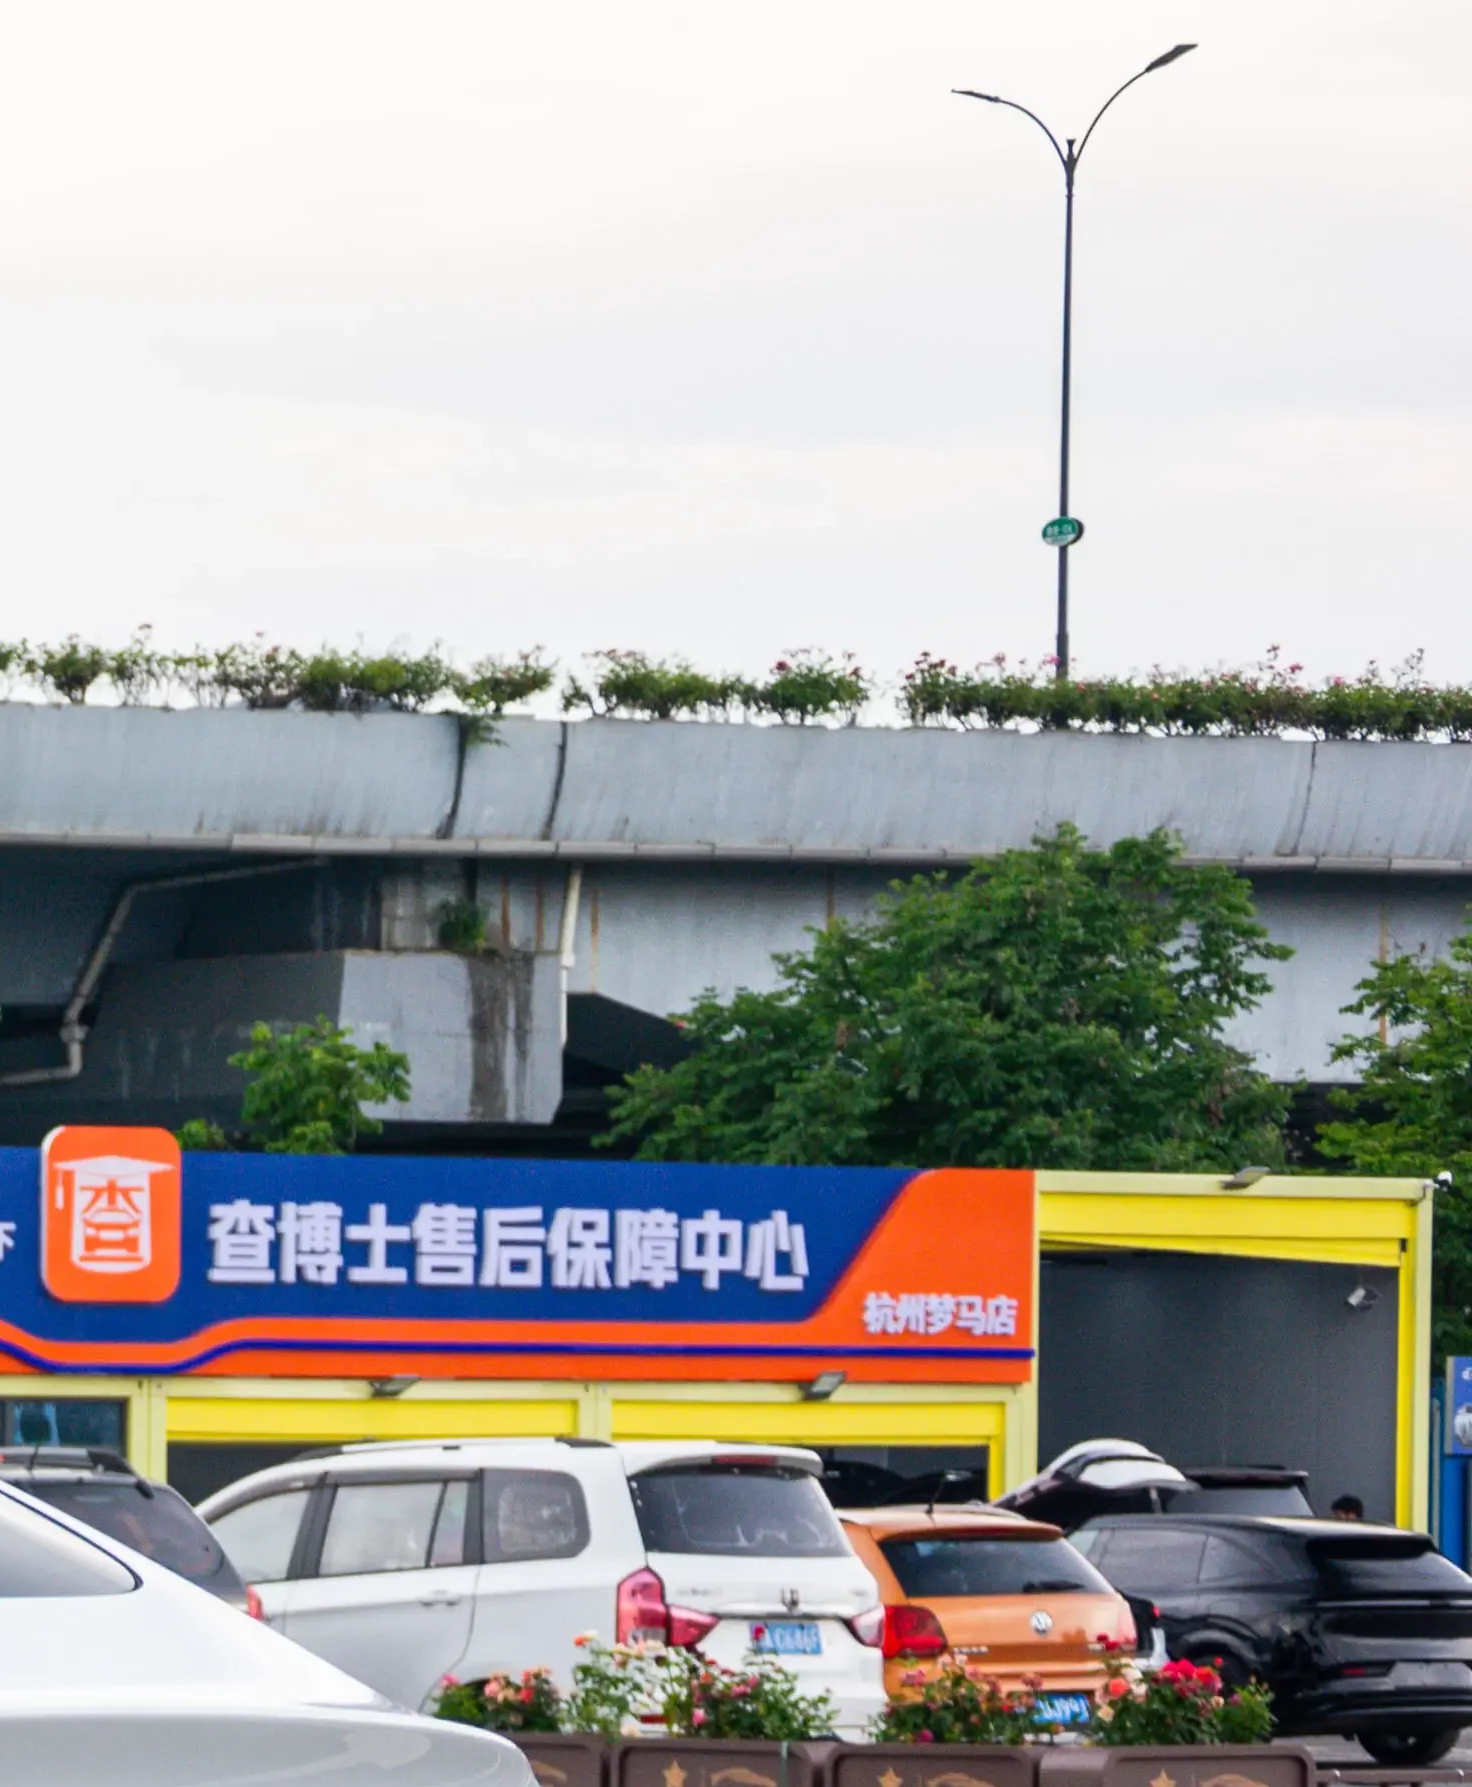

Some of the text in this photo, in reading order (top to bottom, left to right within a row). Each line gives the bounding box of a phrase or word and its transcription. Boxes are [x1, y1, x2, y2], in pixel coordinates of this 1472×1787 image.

[206, 1199, 809, 1291] 查博士售后保障中心
[863, 1291, 1019, 1336] 杭州梦马店
